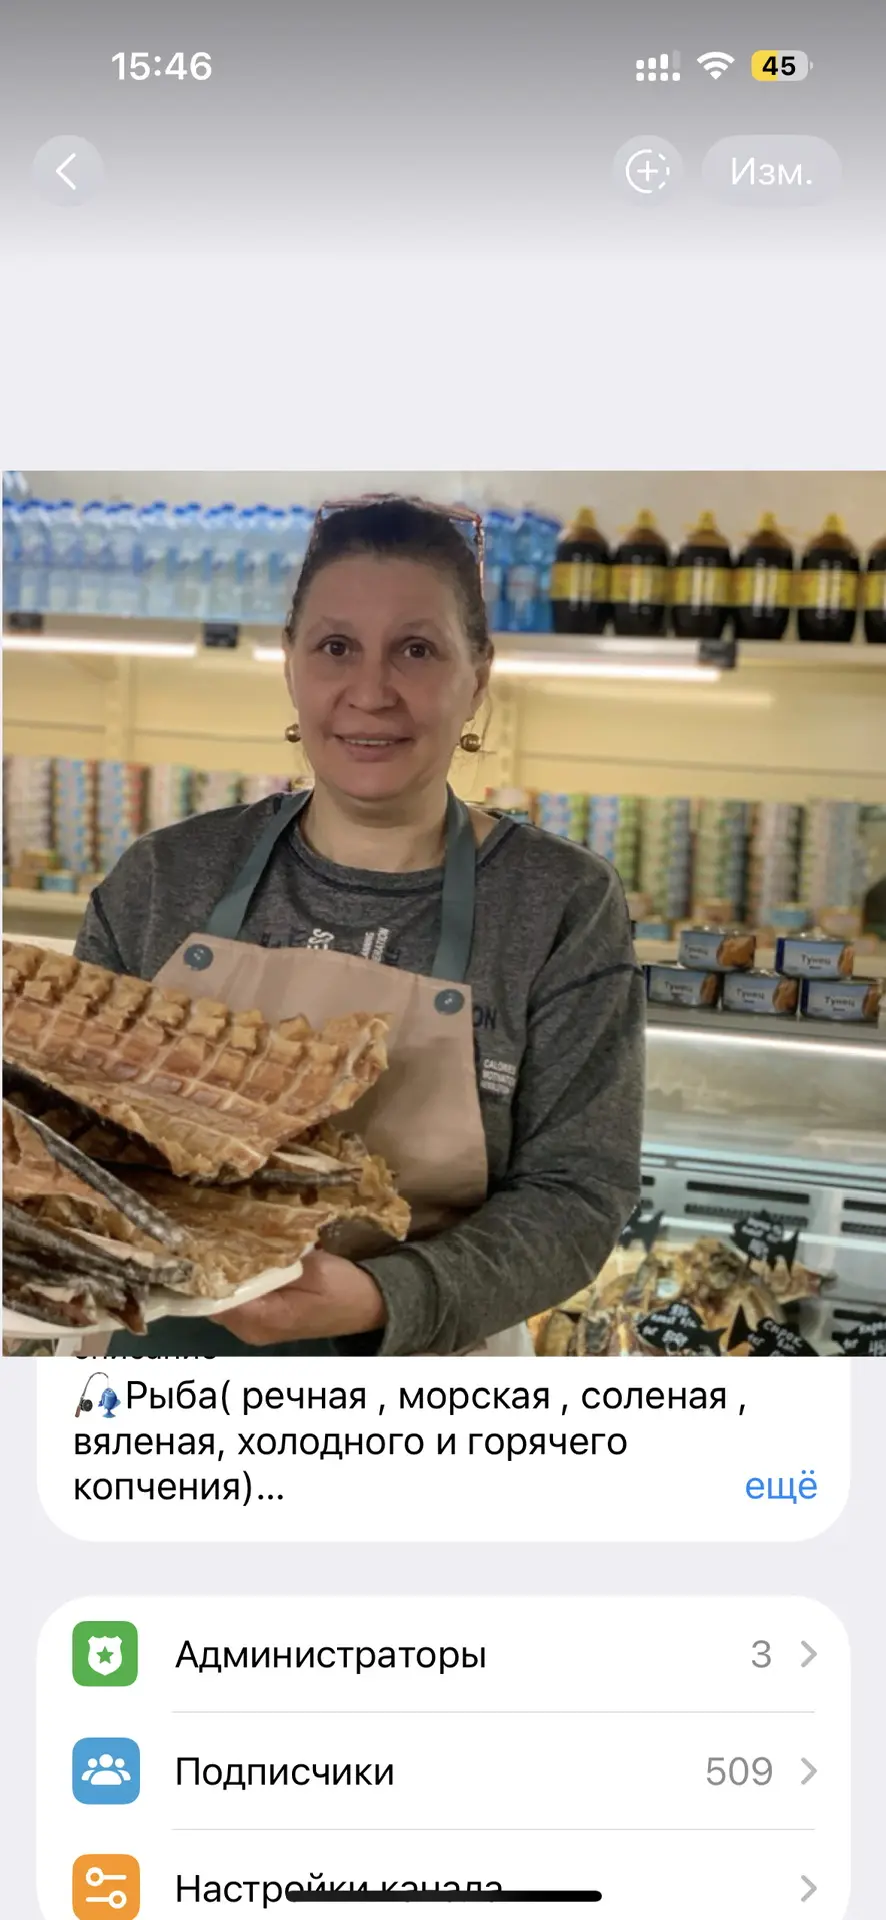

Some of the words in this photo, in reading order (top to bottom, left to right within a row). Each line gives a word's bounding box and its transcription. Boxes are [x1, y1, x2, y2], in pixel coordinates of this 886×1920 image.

[111, 51, 212, 81] 15:46
[762, 56, 796, 76] 45
[732, 157, 812, 186] Изм.
[127, 1379, 231, 1416] Рыба(
[243, 1386, 366, 1416] речная
[399, 1386, 549, 1416] морская
[581, 1386, 726, 1410] соленая
[74, 1432, 224, 1462] вяленая,
[237, 1432, 424, 1461] холодного
[437, 1433, 456, 1455] и
[469, 1432, 627, 1462] горячего
[745, 1469, 818, 1505] ещё
[174, 1639, 486, 1675] Администраторы
[751, 1639, 772, 1669] 3
[176, 1756, 394, 1791] Подписчики
[706, 1756, 773, 1786] 509
